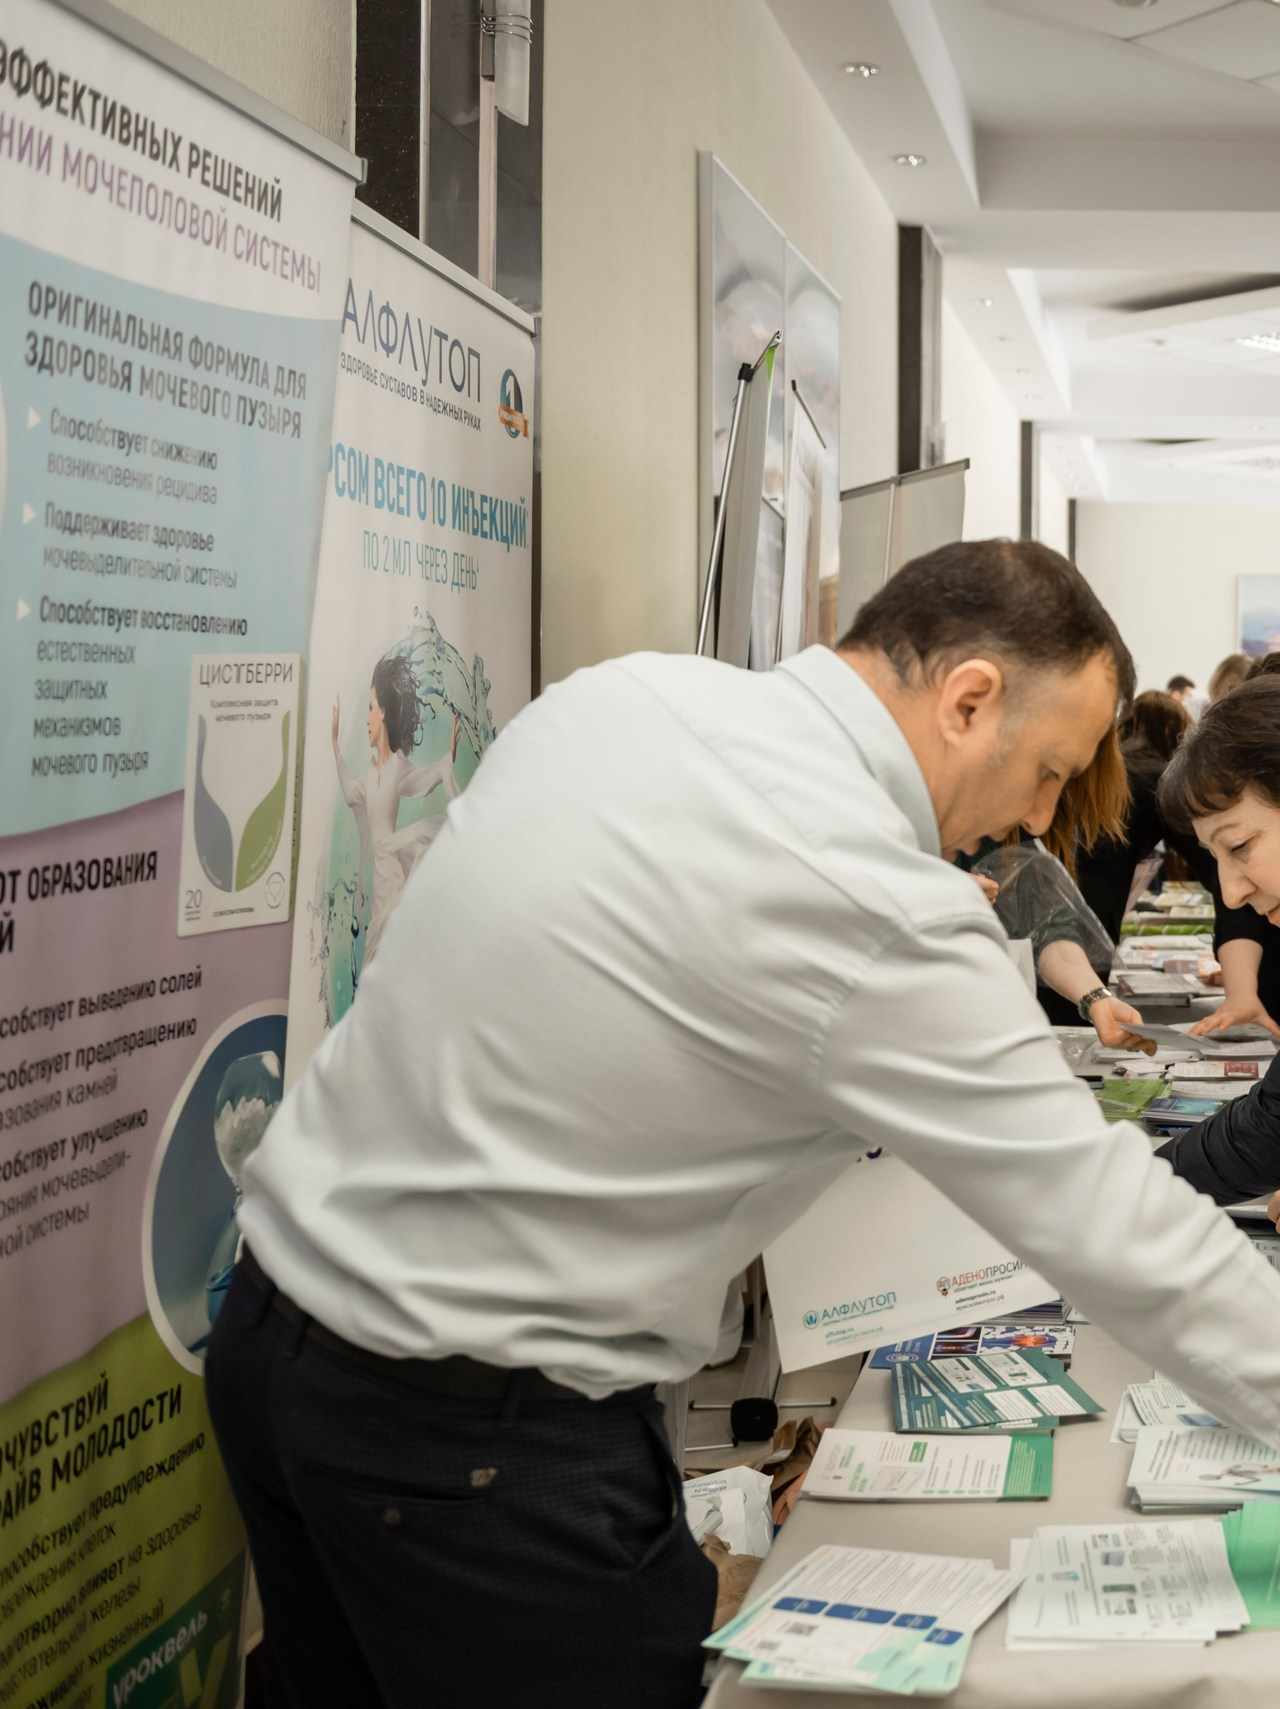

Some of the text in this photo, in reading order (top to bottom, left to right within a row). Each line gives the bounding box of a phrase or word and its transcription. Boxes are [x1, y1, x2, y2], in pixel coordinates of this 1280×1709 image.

[188, 147, 283, 223] РЕШЕНИЙ
[62, 138, 229, 253] МОЧЕПОЛОВОЙ
[233, 229, 321, 294] СИСТЕМЫ
[27, 280, 307, 401] ОРИГИНАЛЬНАЯ ФОРМУЛА ДЛЯ
[341, 276, 481, 403] АЛФЛУТОП
[24, 330, 302, 440] ЗДОРОВЬЯ МОЧЕВОГО ПУЗЫРЯ
[340, 352, 378, 386] ЗДОРОВЬЕ
[379, 372, 418, 403] СУСТАВОВ
[419, 389, 425, 406] В
[425, 391, 463, 423] НАДЕЖНЫХ
[463, 409, 481, 433] РУКАХ
[49, 406, 218, 471] Способствует снижению
[47, 450, 218, 507] возникновения рецидива
[374, 457, 427, 521] ВСЕГО
[430, 476, 447, 527] 10
[45, 501, 214, 554] Поддерживает здоровье
[43, 547, 238, 591] мочевыделительной системы
[363, 530, 379, 571] ПО
[382, 535, 390, 573] 2
[393, 538, 412, 577] МЛ
[415, 542, 448, 585] ЧЕРЕЗ
[39, 595, 248, 638] Способствует восстановлению
[36, 640, 136, 666] естественных
[34, 677, 108, 704] защитных
[33, 715, 121, 740] механизмов
[31, 748, 149, 779] мочевого пузыря
[28, 850, 158, 901] ОБРАЗОВАНИЯ
[185, 888, 203, 909] 20
[79, 979, 156, 1017] выведению
[160, 964, 202, 997] солей
[75, 1016, 197, 1072] предотвращению
[66, 1067, 118, 1107] камней
[71, 1107, 148, 1161] улучшению
[42, 1149, 132, 1201] мочевыдели-
[25, 1201, 90, 1246] системы
[821, 1291, 896, 1321] АЛФЛУТОП
[0, 1382, 183, 1527] АЙВ МОЛОДОСТИ
[87, 1430, 205, 1523] предупреждению
[145, 1503, 203, 1557] здоровье
[88, 1596, 165, 1667] жизненный
